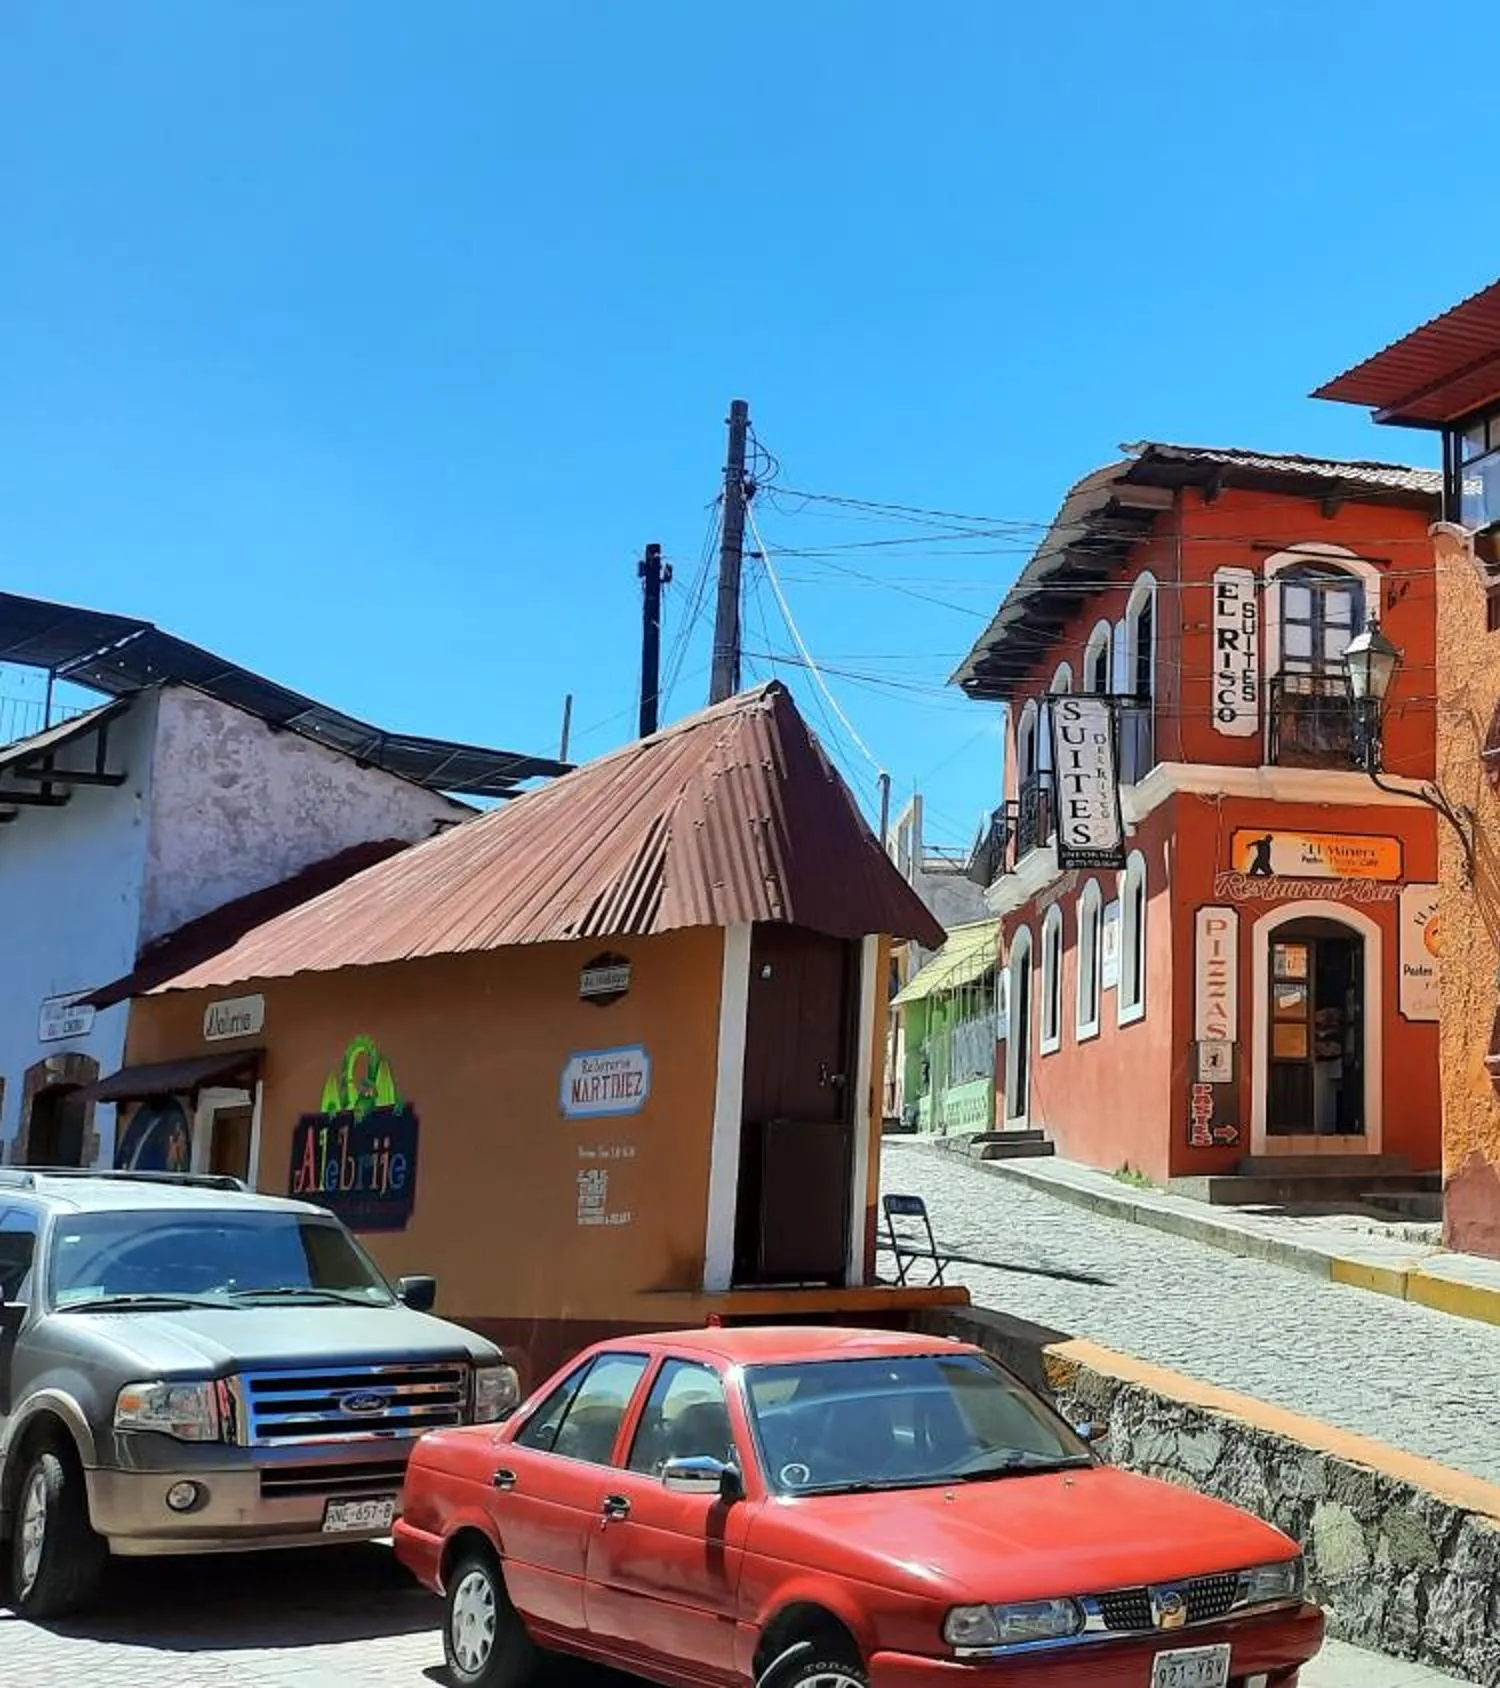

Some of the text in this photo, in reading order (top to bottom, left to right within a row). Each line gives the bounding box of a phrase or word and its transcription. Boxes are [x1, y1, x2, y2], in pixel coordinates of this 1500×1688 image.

[1217, 582, 1239, 722] EL RISCO
[1242, 602, 1256, 702] SUITES
[1061, 701, 1091, 844] SUITES
[1206, 919, 1227, 1041] PIZZAS
[293, 1125, 407, 1197] Alebrije
